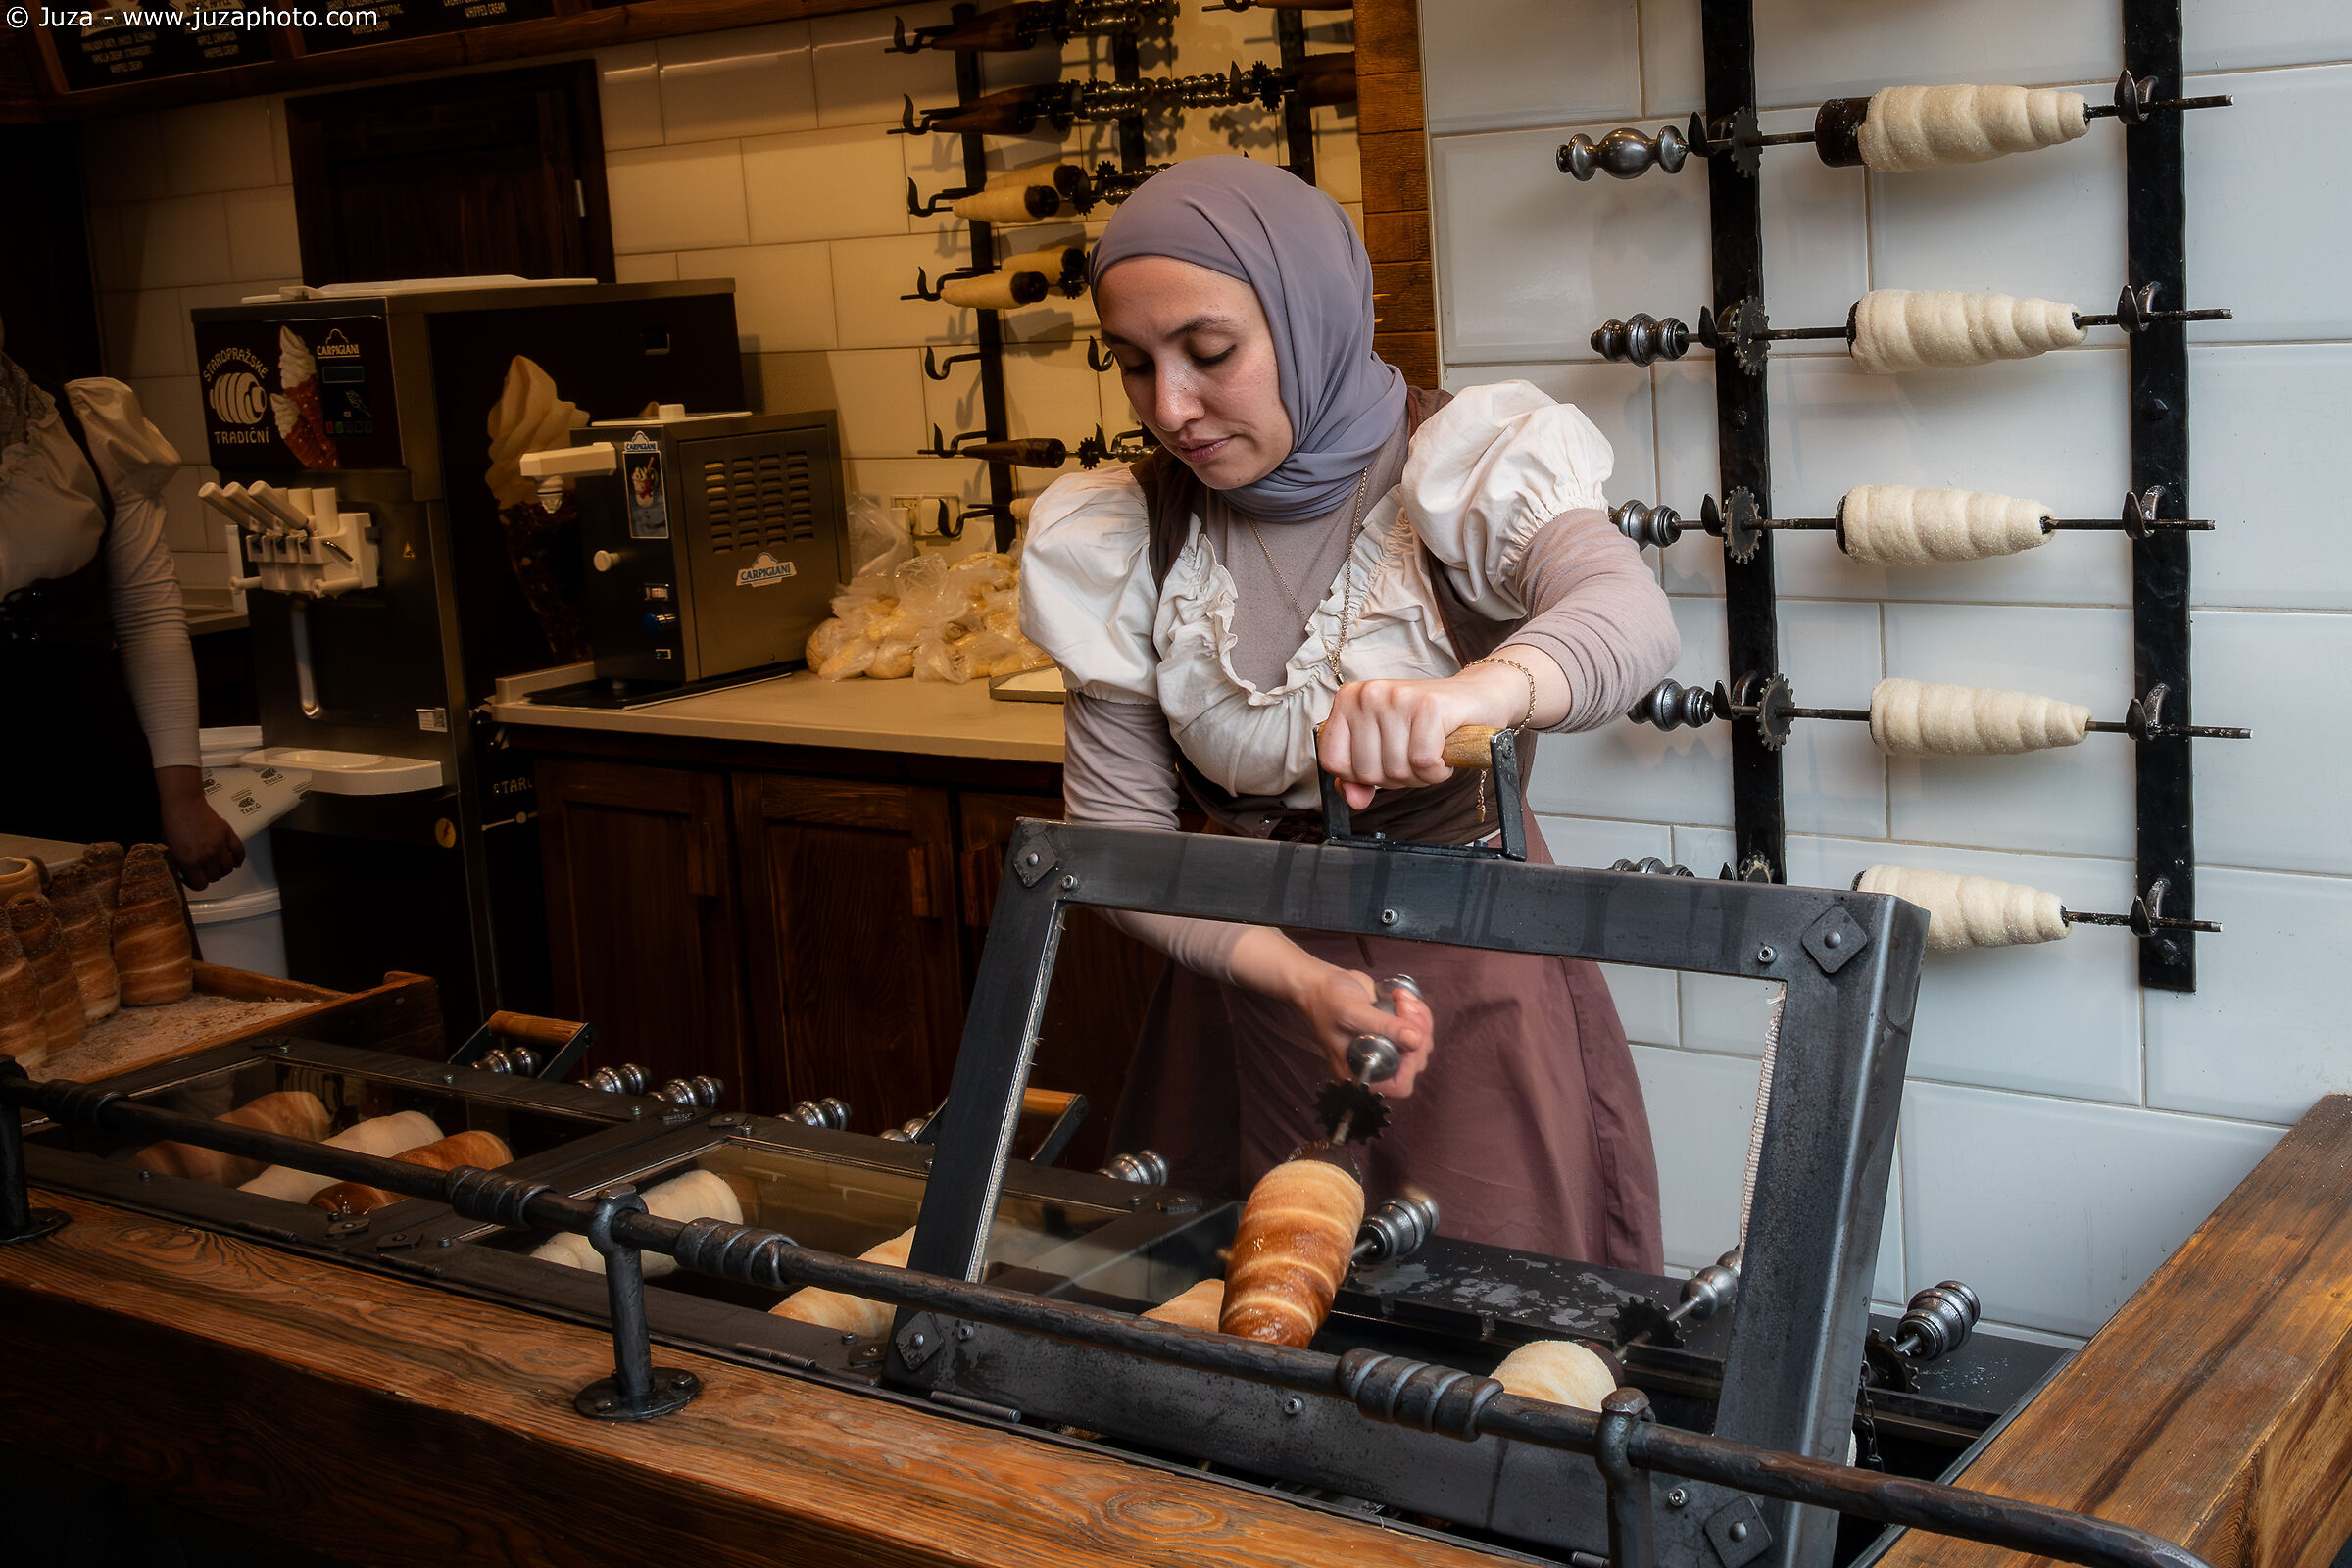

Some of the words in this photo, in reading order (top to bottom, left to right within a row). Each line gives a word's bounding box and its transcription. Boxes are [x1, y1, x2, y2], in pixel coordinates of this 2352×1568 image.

[317, 343, 361, 356] CARPIGIANI
[203, 347, 270, 383] STAROPRAŽSKÉ
[213, 426, 270, 444] TRADIČNÍ
[740, 564, 792, 581] CARPIGIANI
